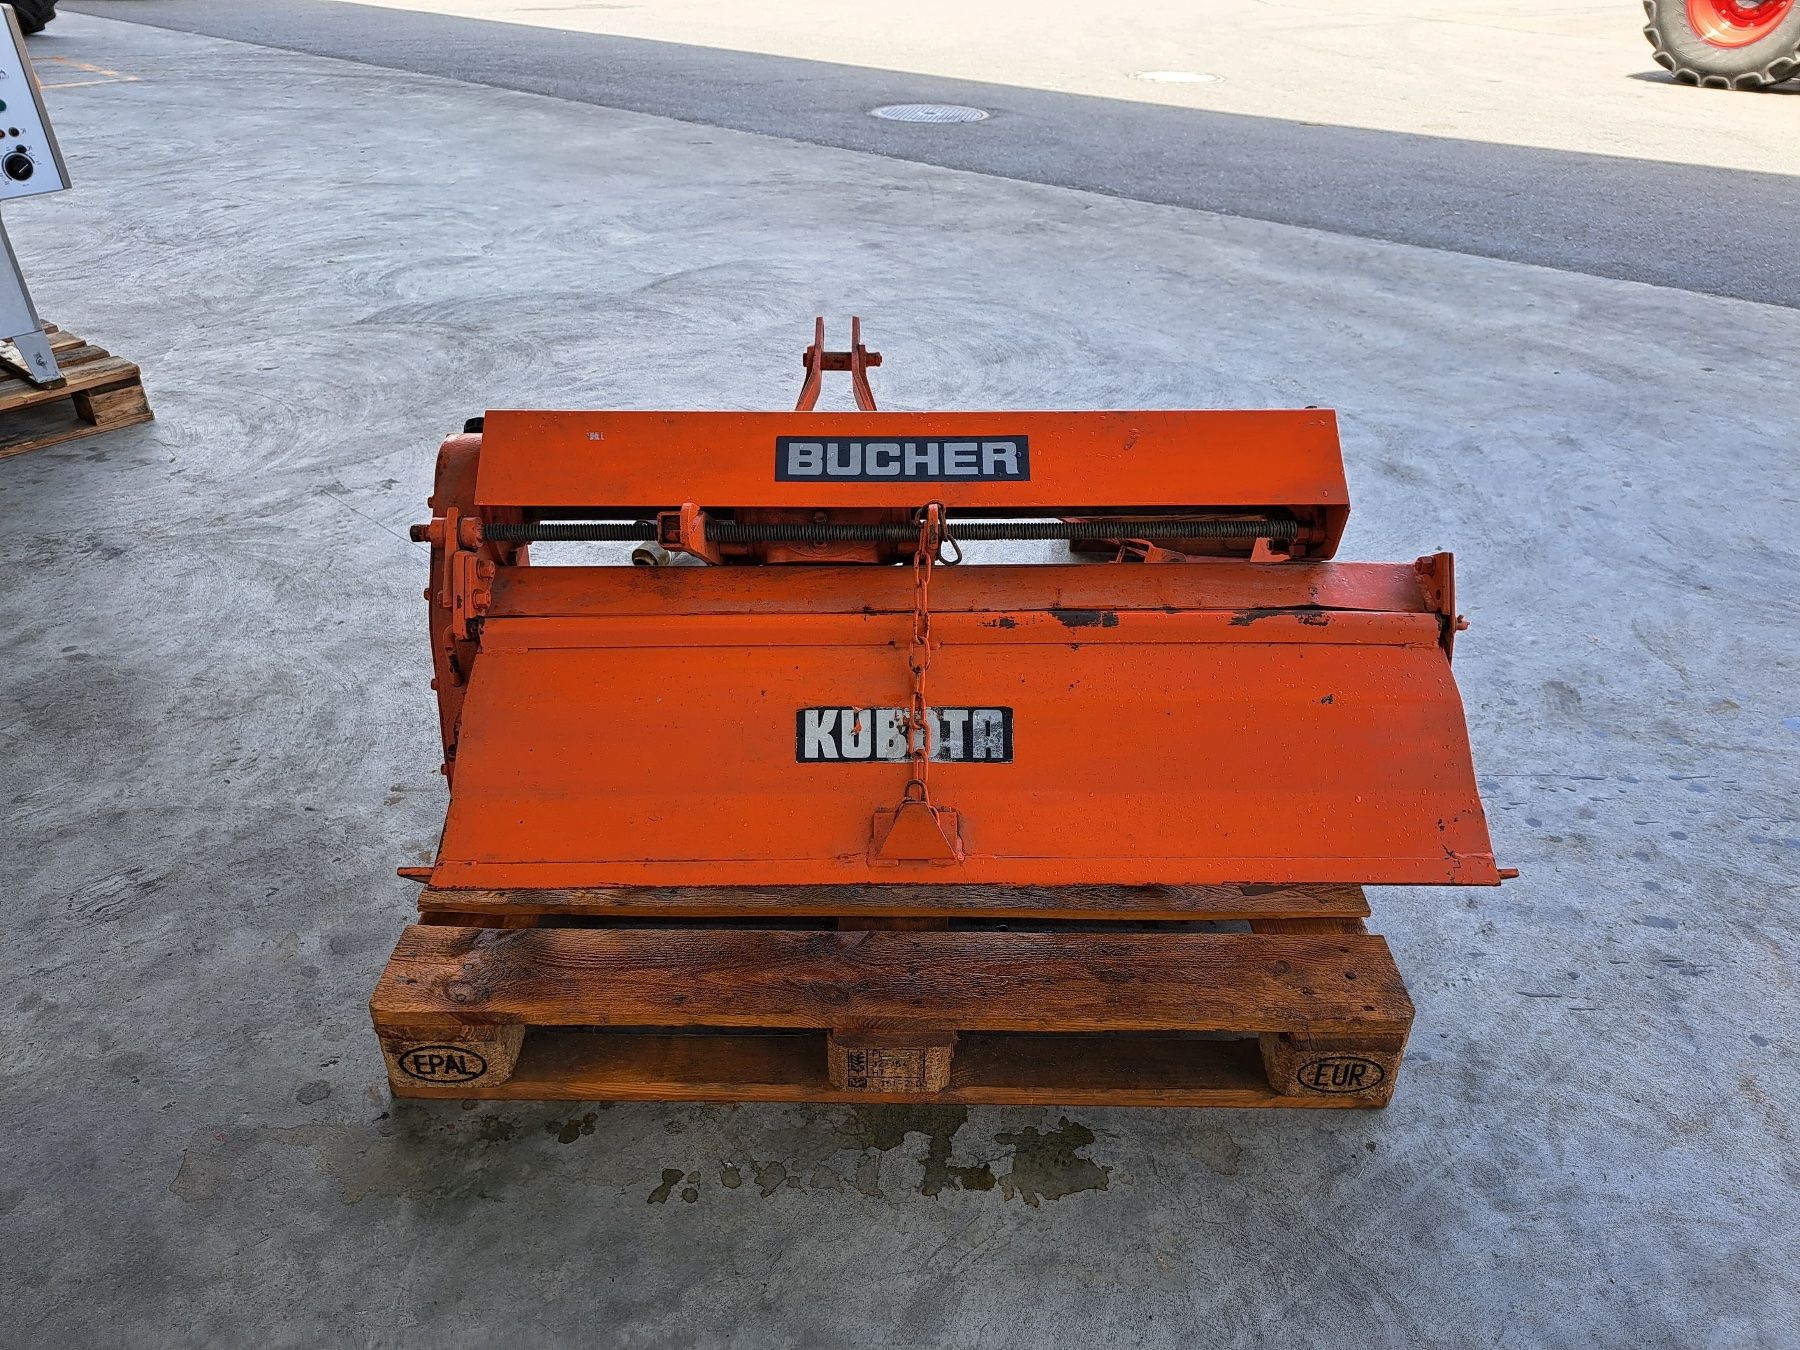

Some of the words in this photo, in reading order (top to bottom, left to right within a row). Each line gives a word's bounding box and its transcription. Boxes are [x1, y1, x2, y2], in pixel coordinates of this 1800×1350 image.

[787, 441, 1020, 476] BUCHER
[412, 1054, 477, 1075] EPAL
[1313, 1062, 1367, 1087] EUR
